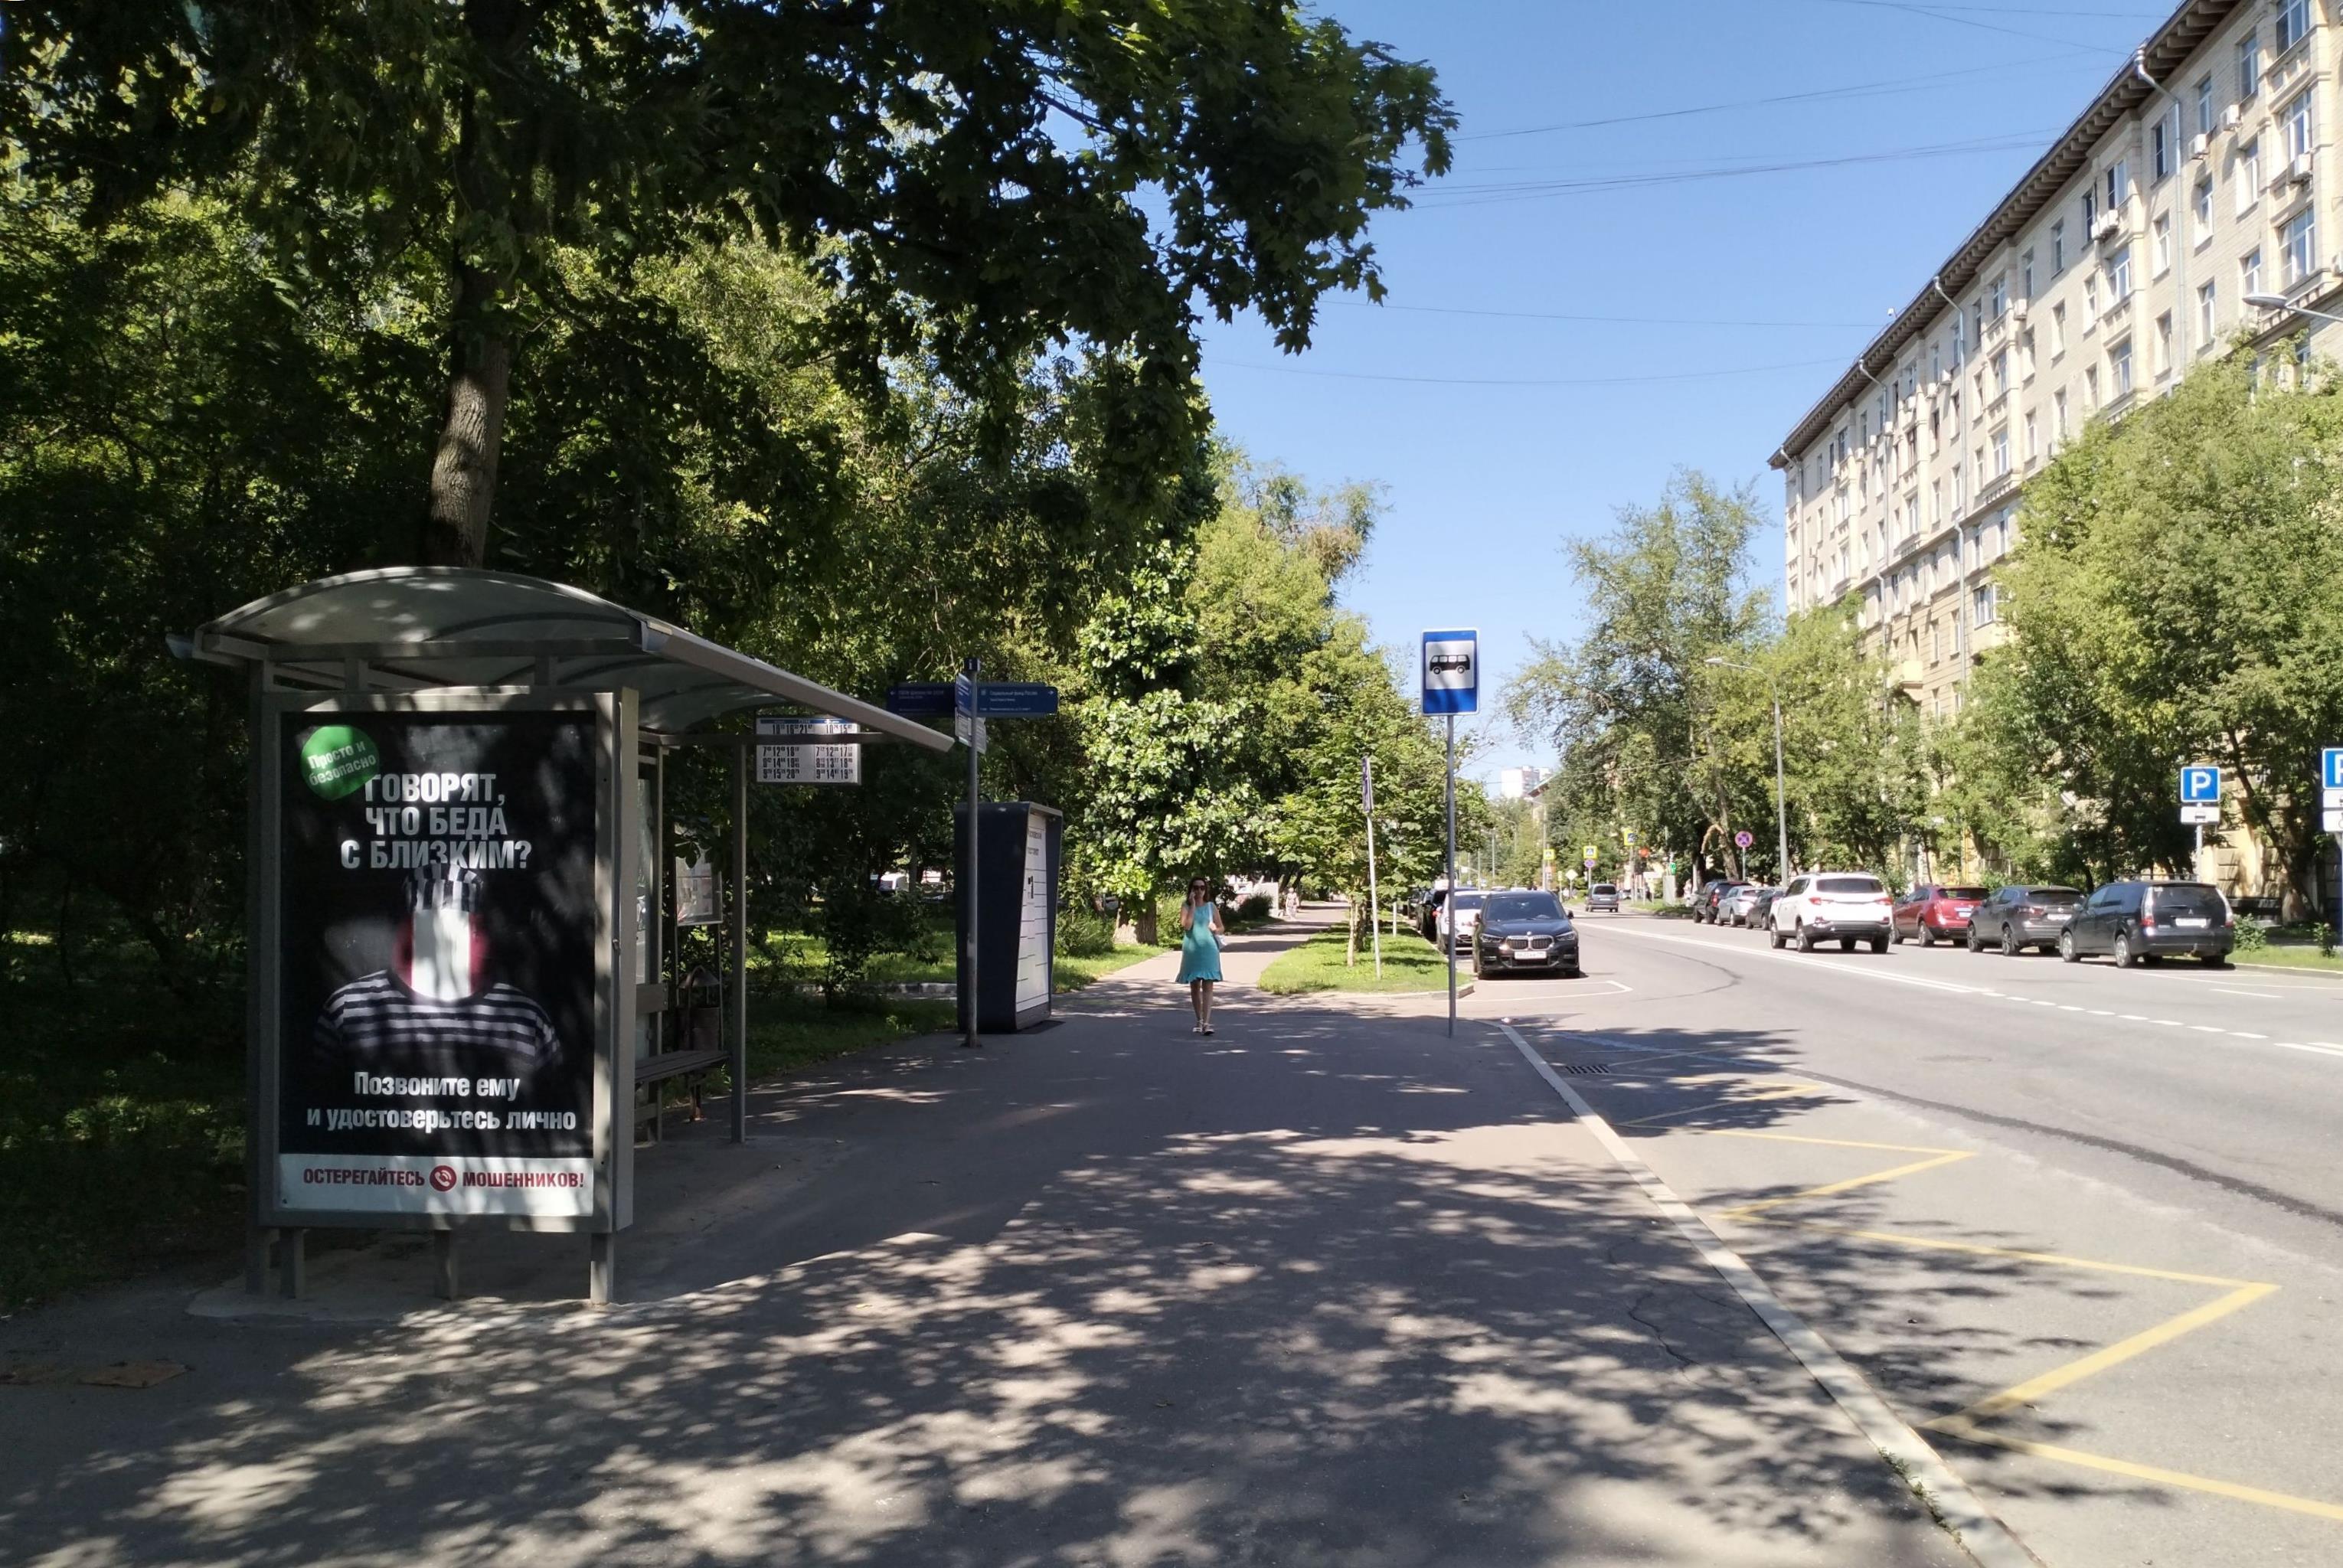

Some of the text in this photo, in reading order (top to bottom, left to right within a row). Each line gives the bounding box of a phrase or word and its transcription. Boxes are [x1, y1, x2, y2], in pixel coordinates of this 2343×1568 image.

[308, 740, 366, 769] Просто и
[309, 753, 377, 786] безопасно
[364, 773, 505, 805] ГОВОРЯТ,
[2191, 771, 2211, 798] P
[365, 806, 508, 841] ЧТО БЕДА
[341, 840, 532, 870] С БЛИЗКИМ?
[355, 1071, 521, 1102] Позвоните ему
[307, 1107, 577, 1134] и удостоверьтесь лично
[302, 1167, 585, 1188] ОСТЕРЕГАЙТЕСЬ МОШЕННИКОВ!
